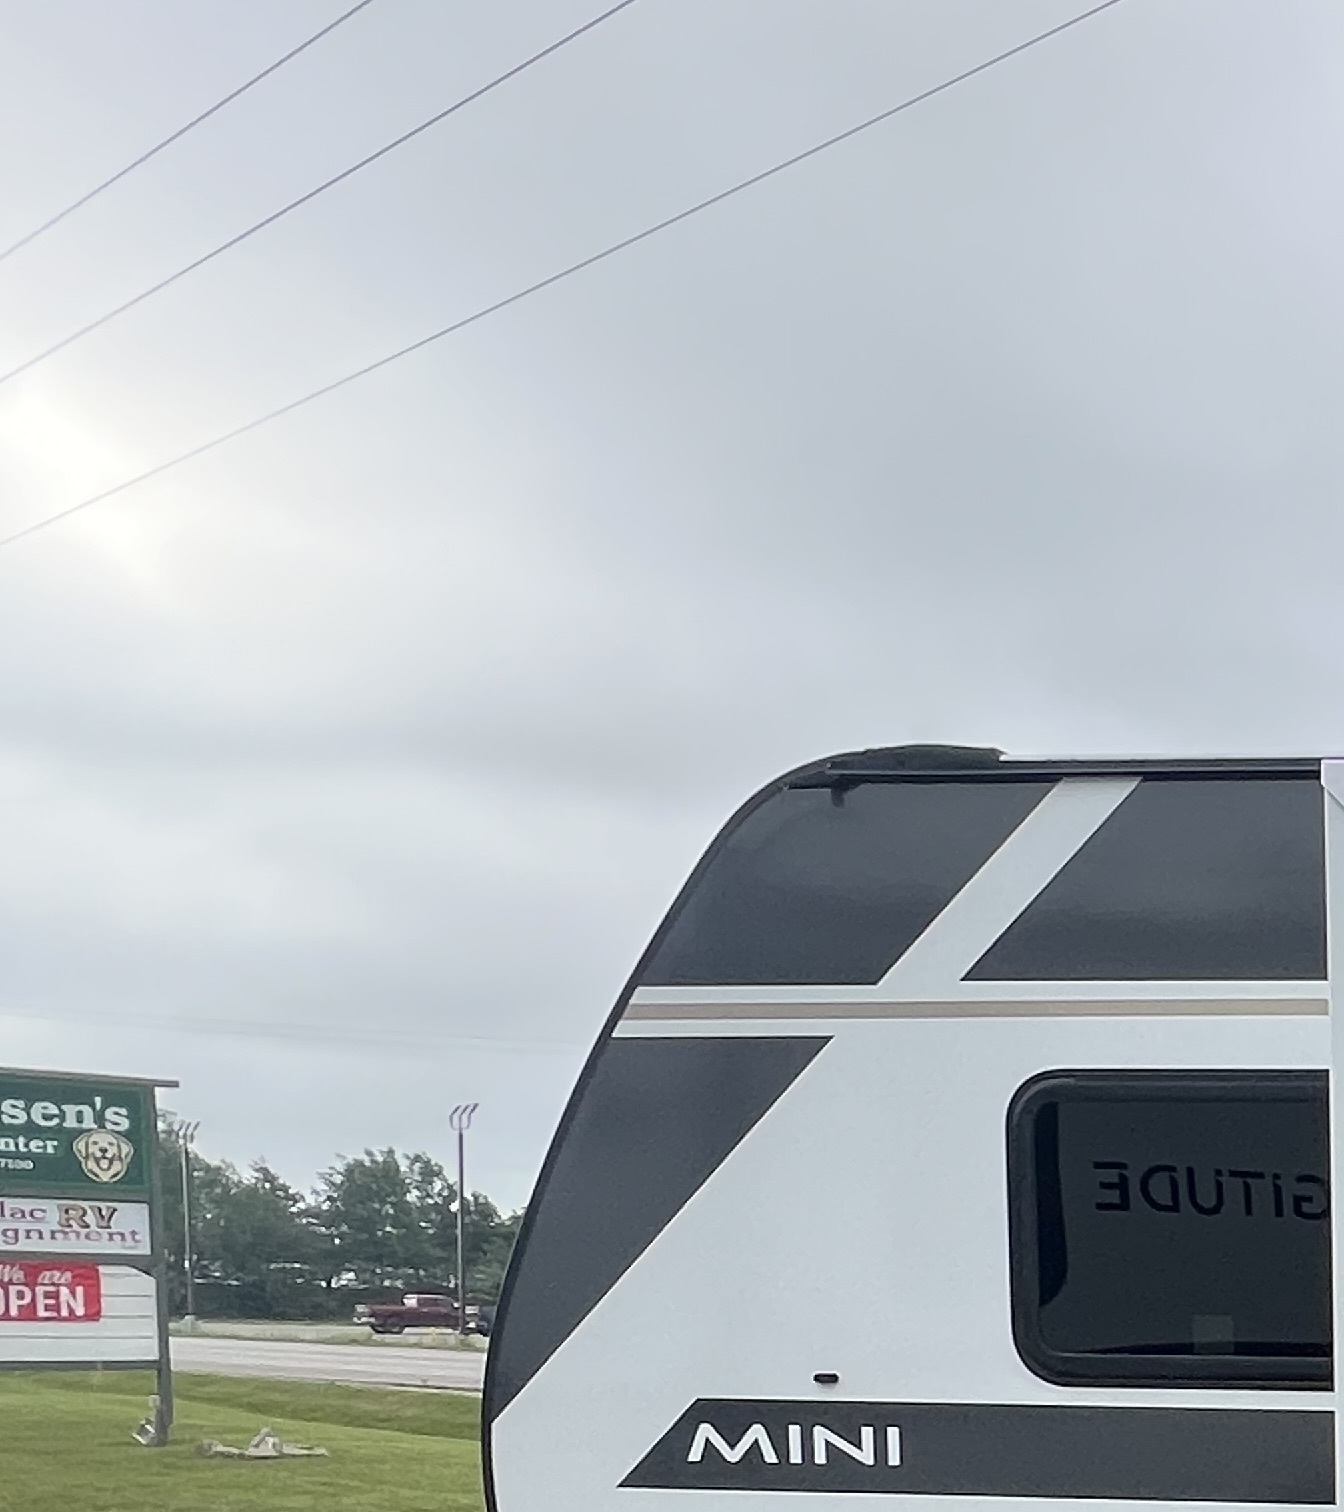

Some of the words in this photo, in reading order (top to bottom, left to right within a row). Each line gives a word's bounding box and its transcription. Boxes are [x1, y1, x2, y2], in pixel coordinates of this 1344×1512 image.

[0, 1134, 58, 1154] nter
[57, 1204, 118, 1230] RV
[0, 1228, 142, 1245] gnment
[0, 1284, 86, 1318] PEN
[685, 1422, 902, 1468] MINI
